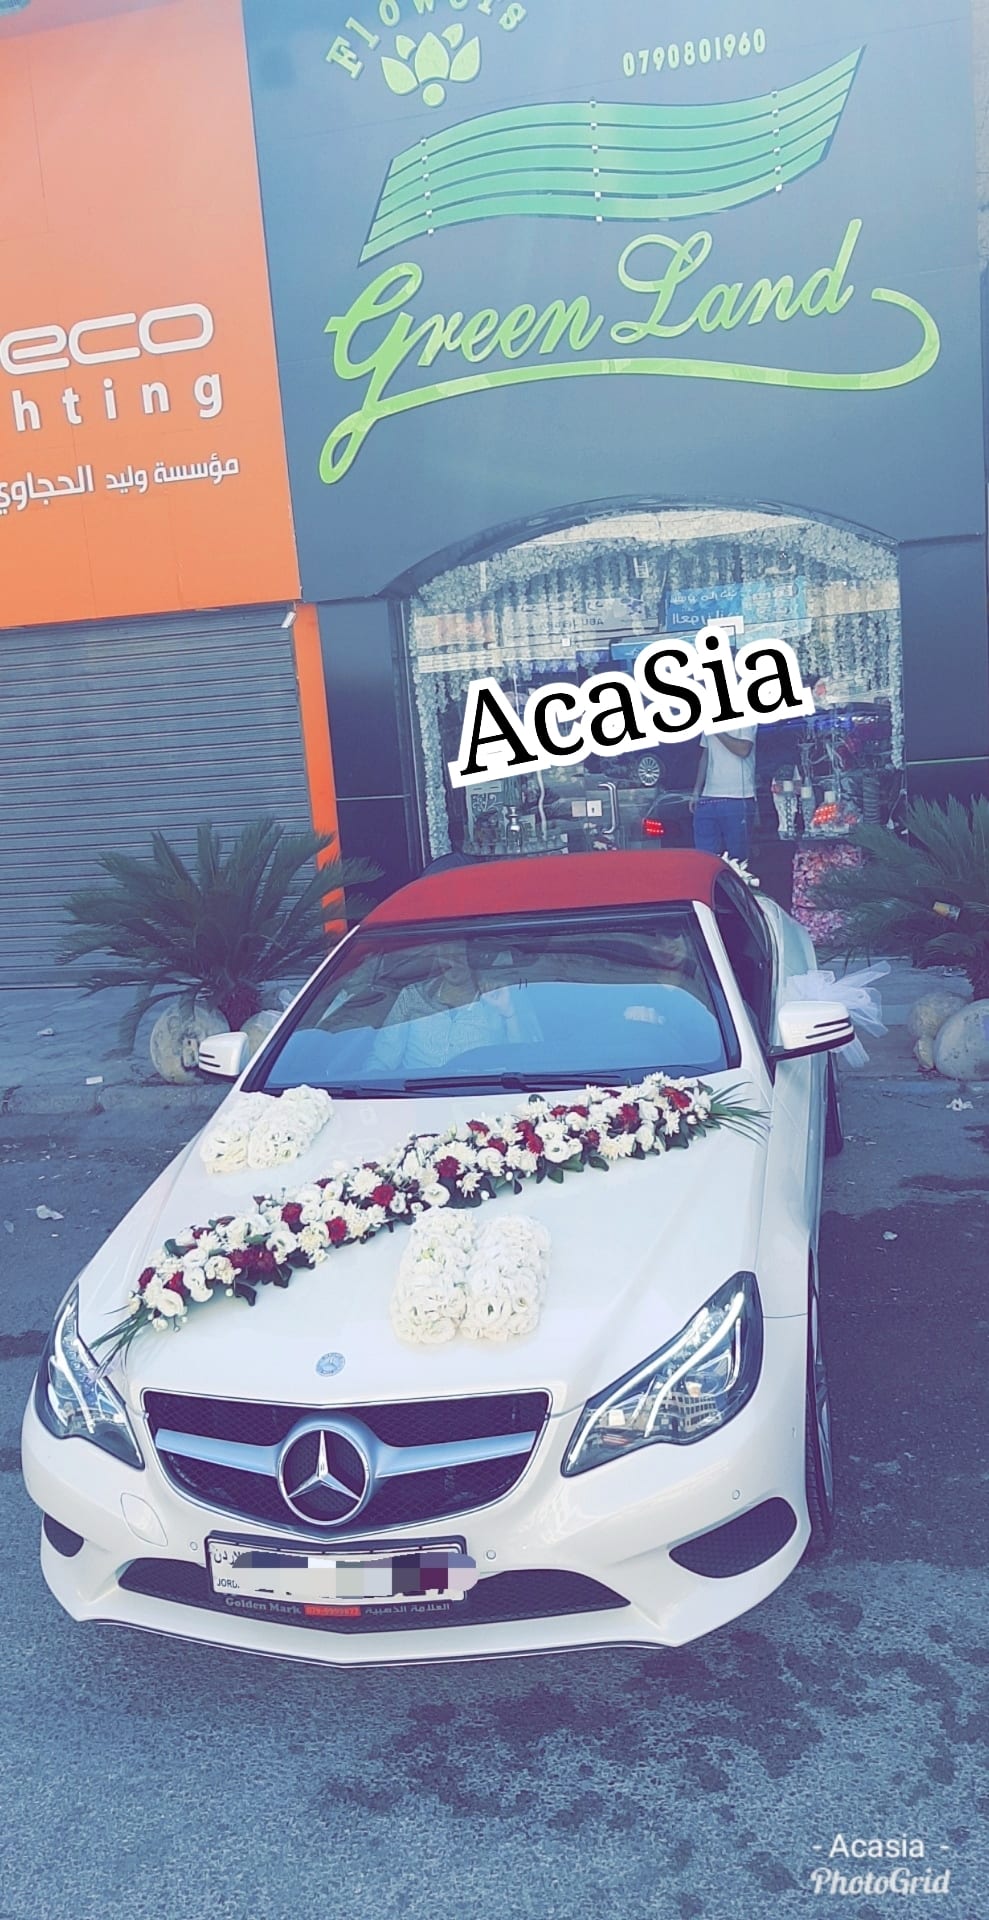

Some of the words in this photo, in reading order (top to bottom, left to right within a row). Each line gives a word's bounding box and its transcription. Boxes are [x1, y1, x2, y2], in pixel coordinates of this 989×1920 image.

[623, 27, 766, 77] 0790801960
[0, 303, 214, 375] eco
[319, 262, 604, 484] Green
[610, 218, 863, 345] Land
[11, 373, 223, 432] hting
[105, 465, 149, 494] وليد
[153, 452, 240, 485] مؤسسة
[225, 1597, 267, 1610] Golden
[269, 1602, 302, 1614] Mark
